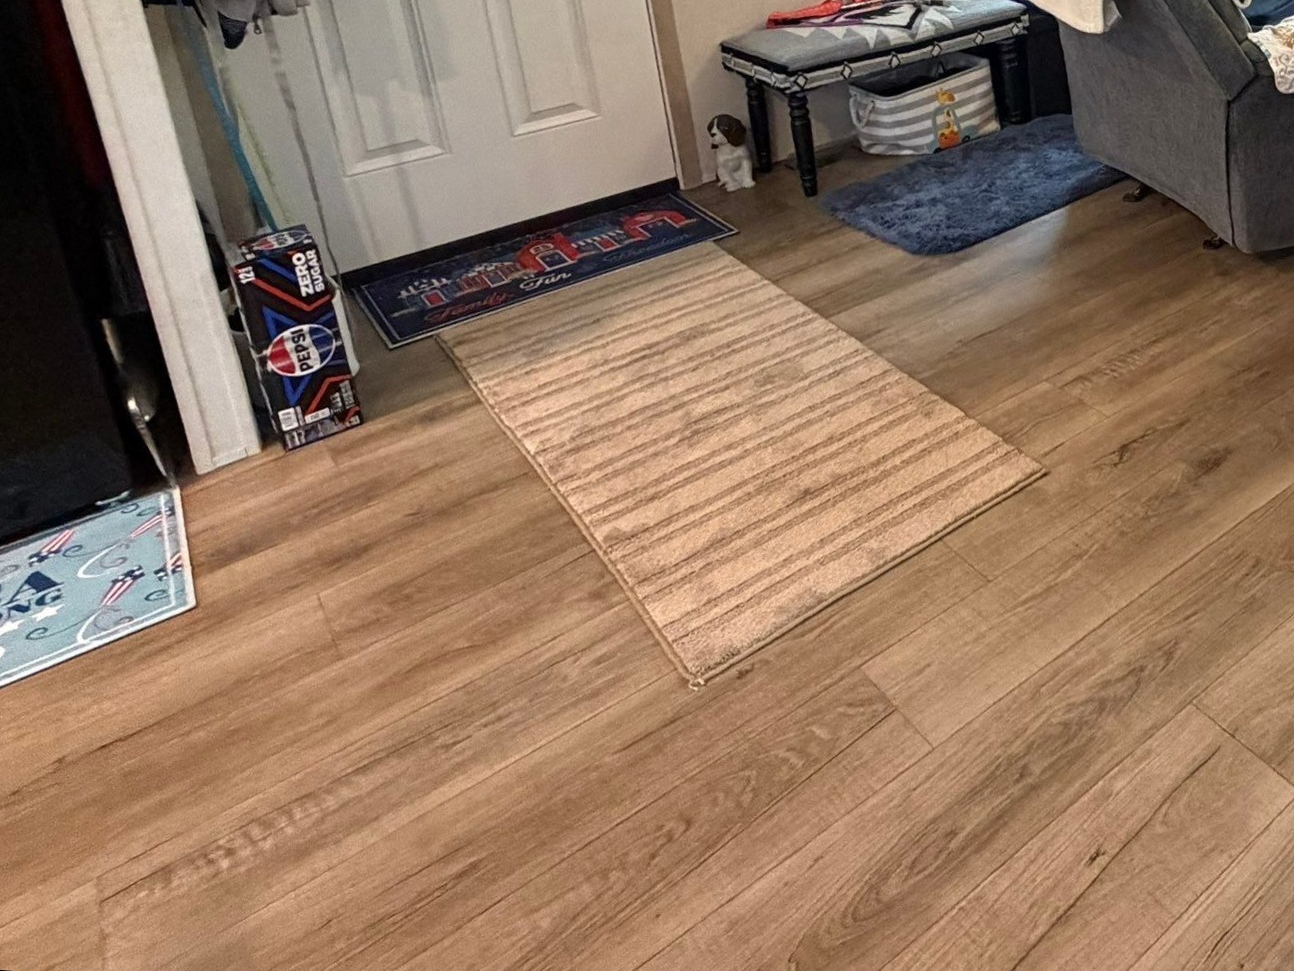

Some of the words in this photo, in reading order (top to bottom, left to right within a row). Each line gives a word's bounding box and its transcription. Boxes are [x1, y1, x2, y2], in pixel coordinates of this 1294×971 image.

[292, 252, 315, 298] ZERO
[305, 249, 326, 293] SUGAR
[519, 273, 572, 291] Fun
[290, 328, 314, 373] PEPSI
